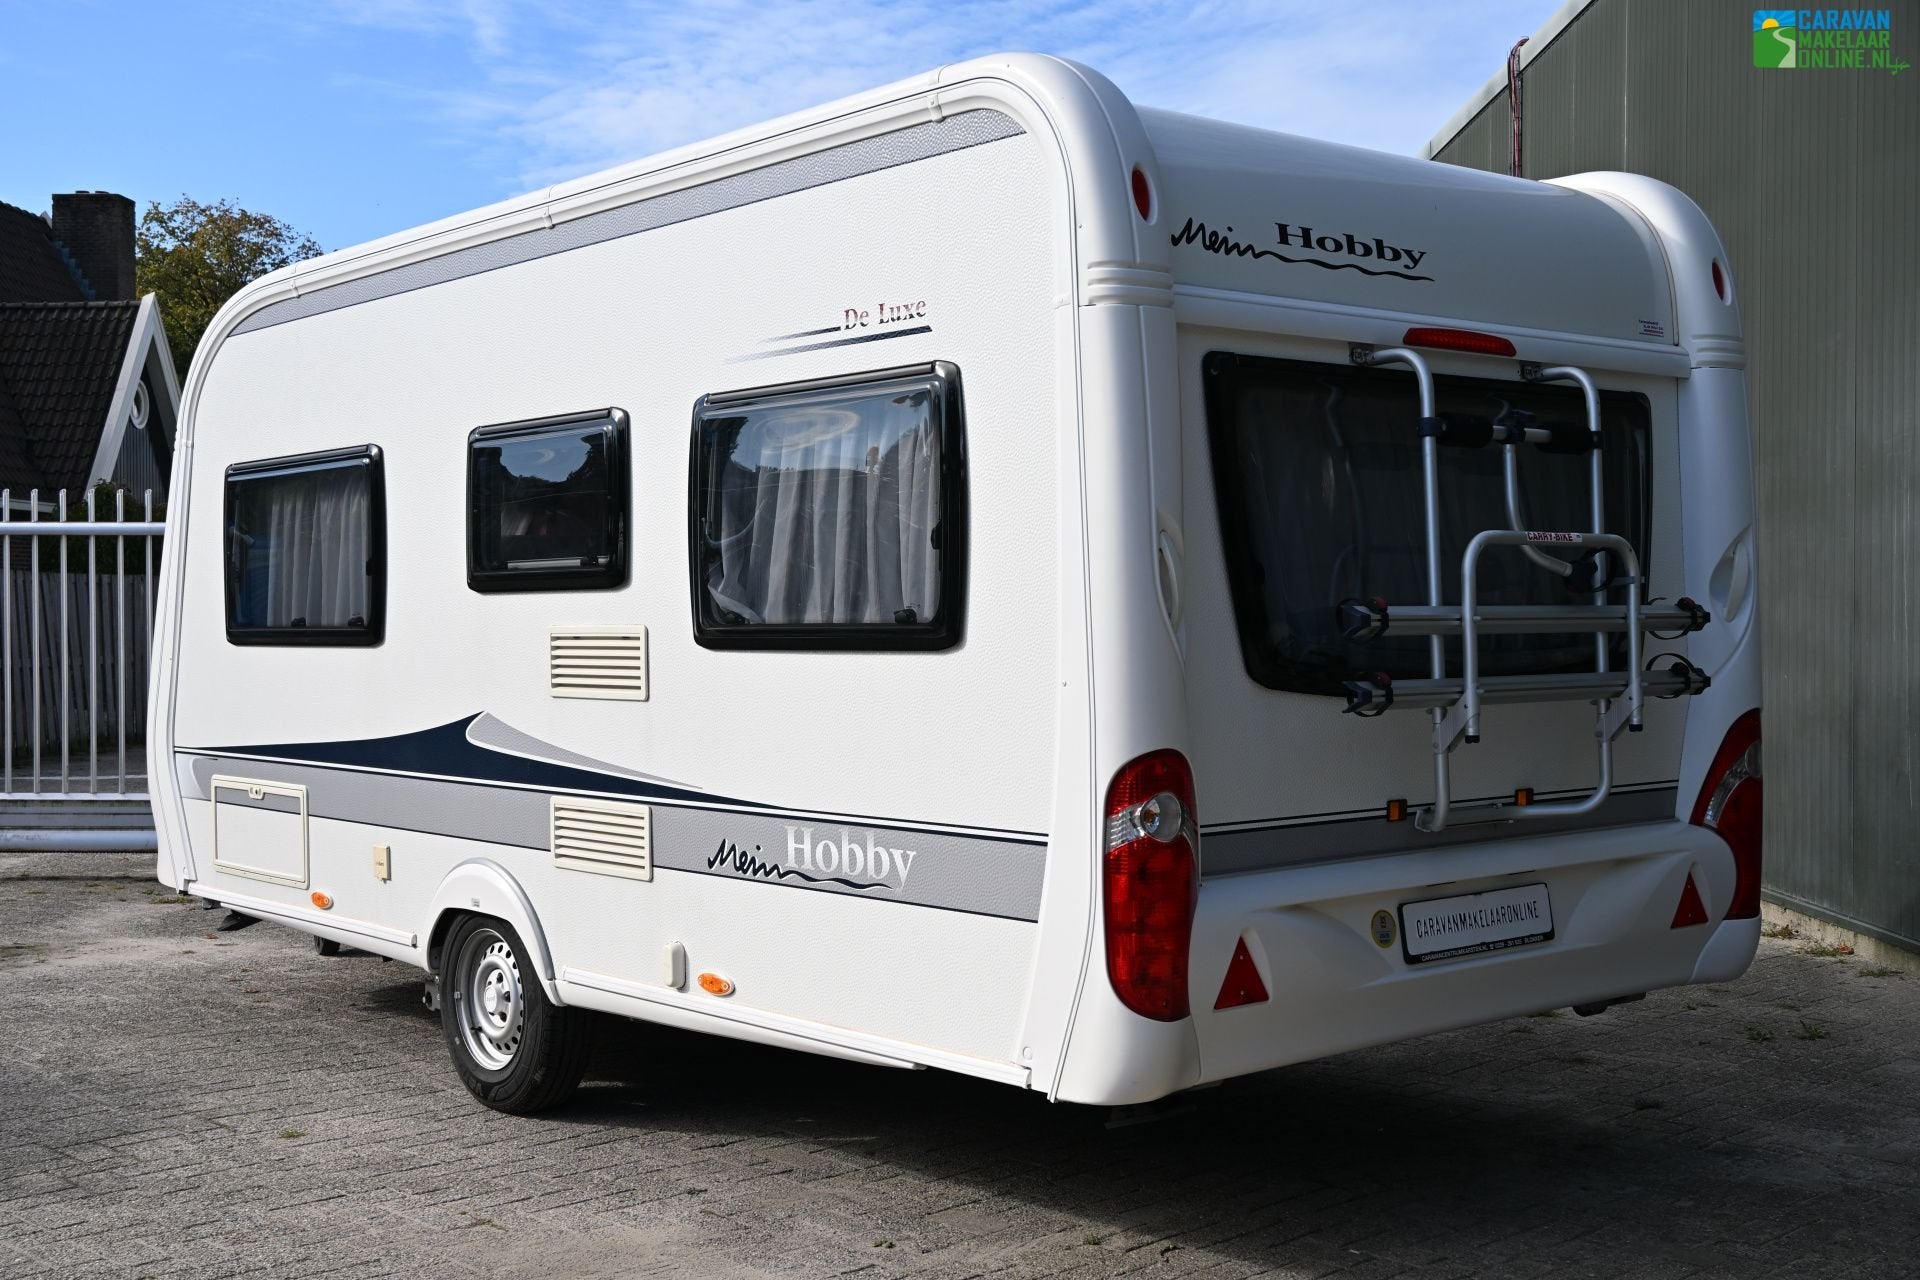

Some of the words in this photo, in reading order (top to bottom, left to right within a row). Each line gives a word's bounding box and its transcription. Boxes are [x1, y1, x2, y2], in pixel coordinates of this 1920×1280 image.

[1170, 216, 1260, 260] Mein
[1274, 222, 1427, 270] Hobby
[843, 308, 870, 331] De
[877, 299, 927, 325] Luxe
[1527, 532, 1574, 542] CARRY-BIKE
[707, 837, 785, 880] Mein
[783, 823, 917, 896] Hobby
[1415, 900, 1540, 939] CARAVANMAKELAARONLINE
